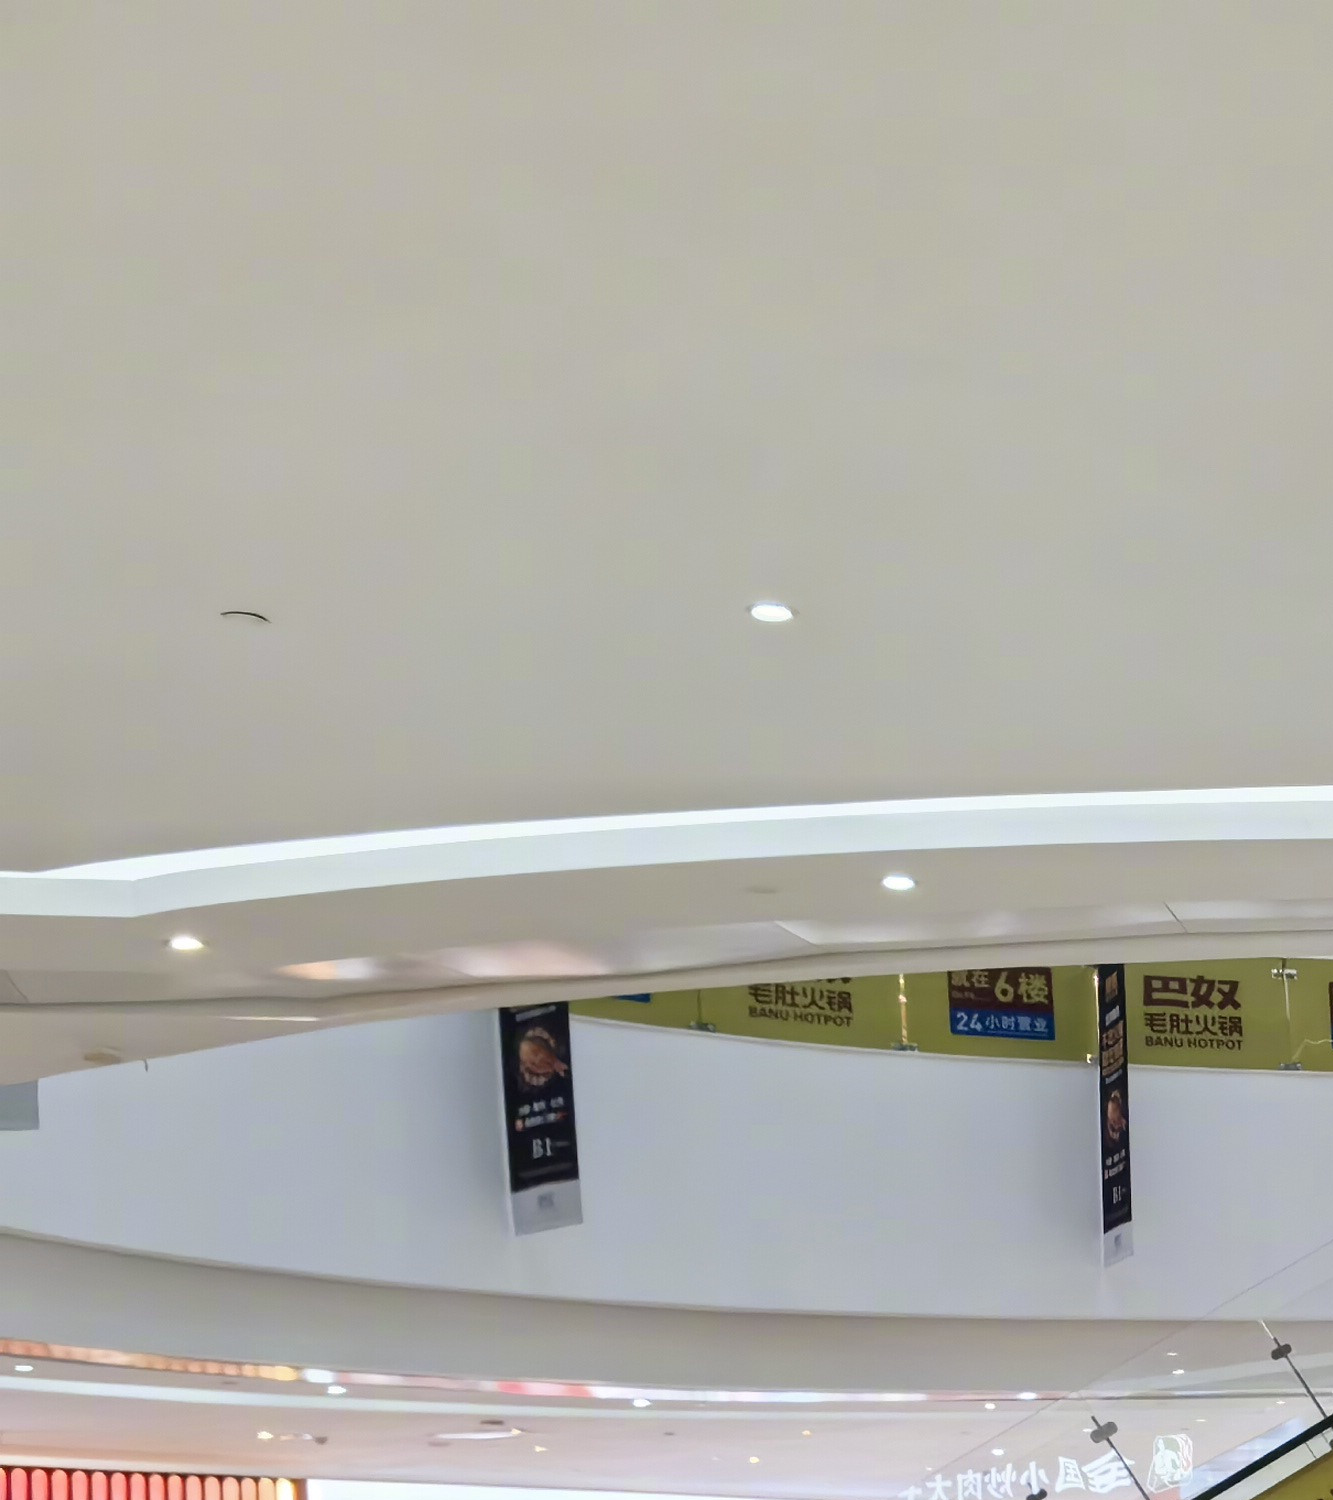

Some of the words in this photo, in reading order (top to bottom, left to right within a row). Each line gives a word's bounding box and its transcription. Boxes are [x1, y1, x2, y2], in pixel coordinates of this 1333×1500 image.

[748, 983, 854, 1013] 毛肚火锅
[1143, 975, 1242, 1011] 巴奴
[749, 1006, 789, 1021] BANU
[793, 1010, 853, 1027] HOTPOT
[1144, 1012, 1243, 1037] 毛肚火锅
[1145, 1035, 1184, 1049] BANU
[1187, 1037, 1244, 1051] HOTPOT
